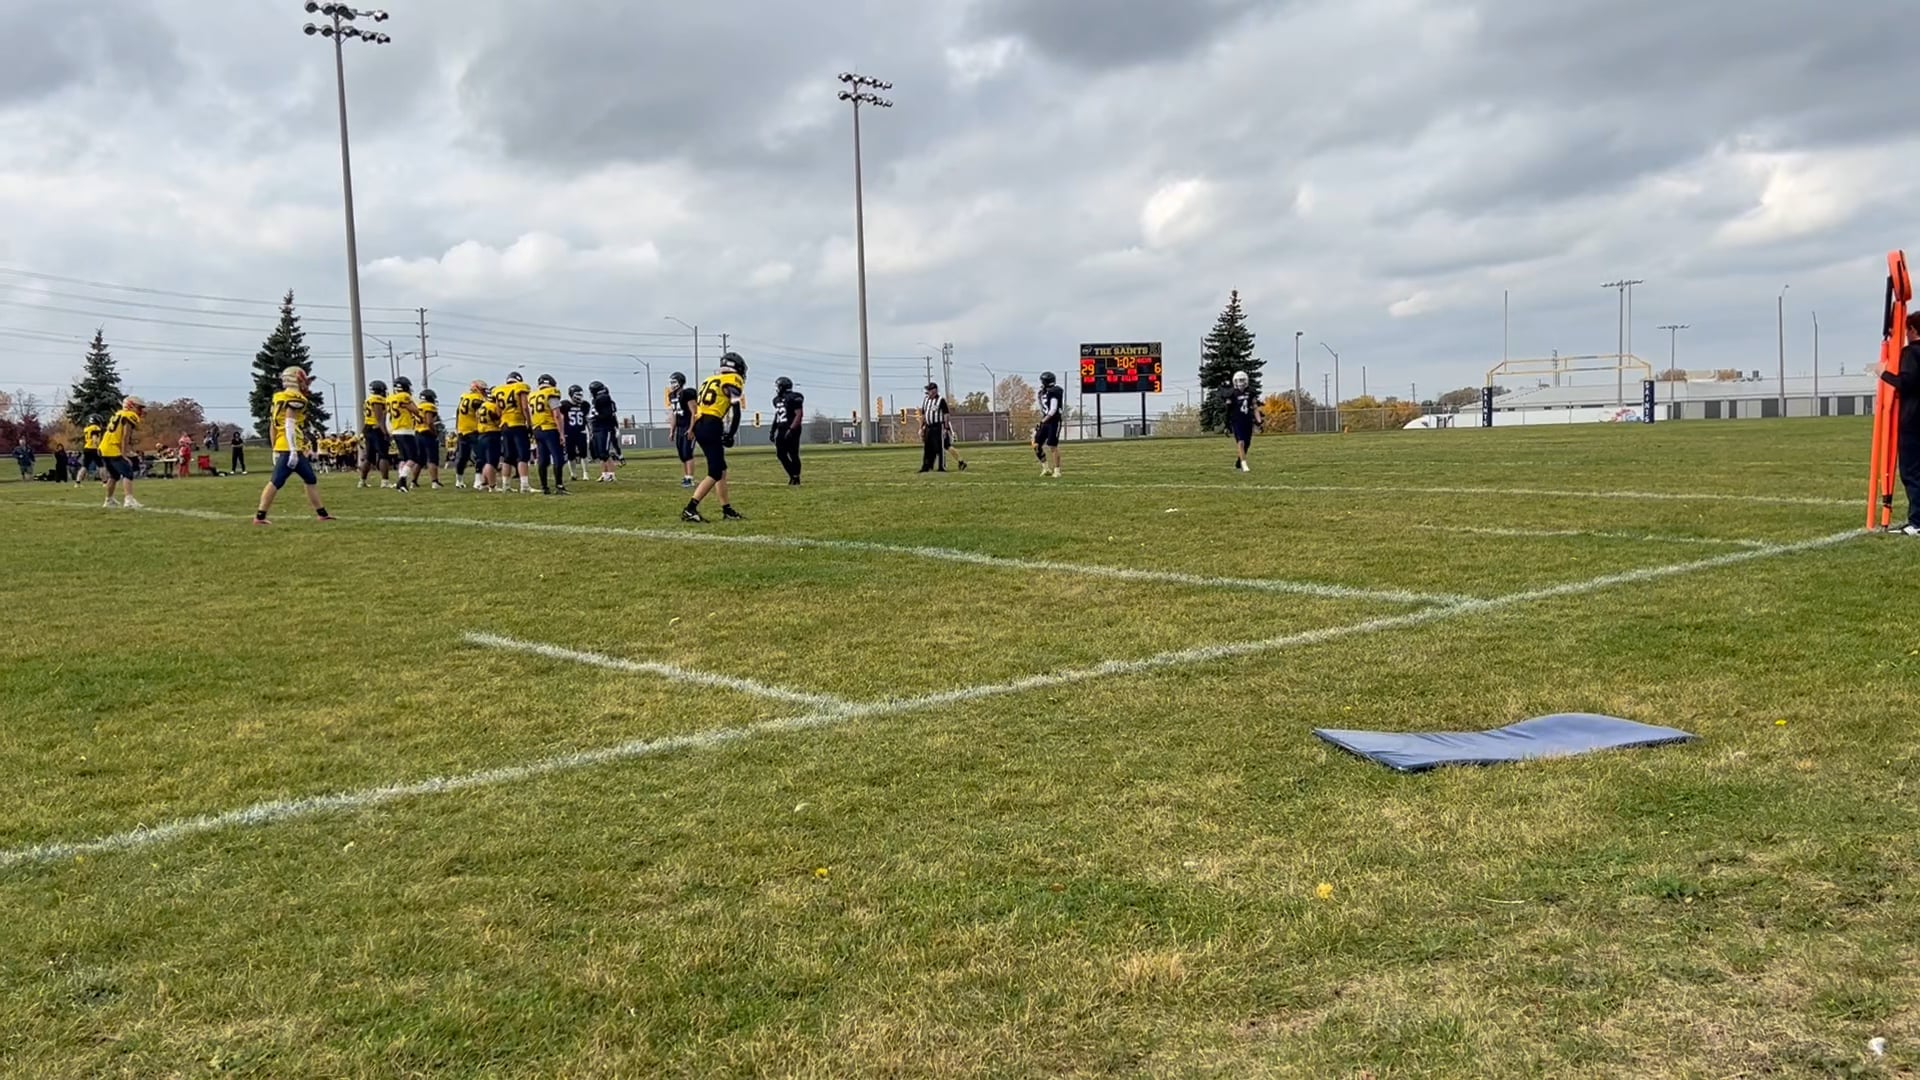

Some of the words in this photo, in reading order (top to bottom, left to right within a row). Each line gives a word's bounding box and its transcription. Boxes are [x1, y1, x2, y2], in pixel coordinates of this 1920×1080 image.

[1094, 347, 1112, 356] THE
[1113, 346, 1148, 355] SAINTS
[1114, 356, 1136, 369] 7:02
[1154, 362, 1162, 374] 6
[1081, 364, 1095, 376] 29
[1154, 381, 1161, 392] 3
[495, 390, 517, 410] 64
[1240, 399, 1249, 415] 4
[568, 411, 584, 426] 56
